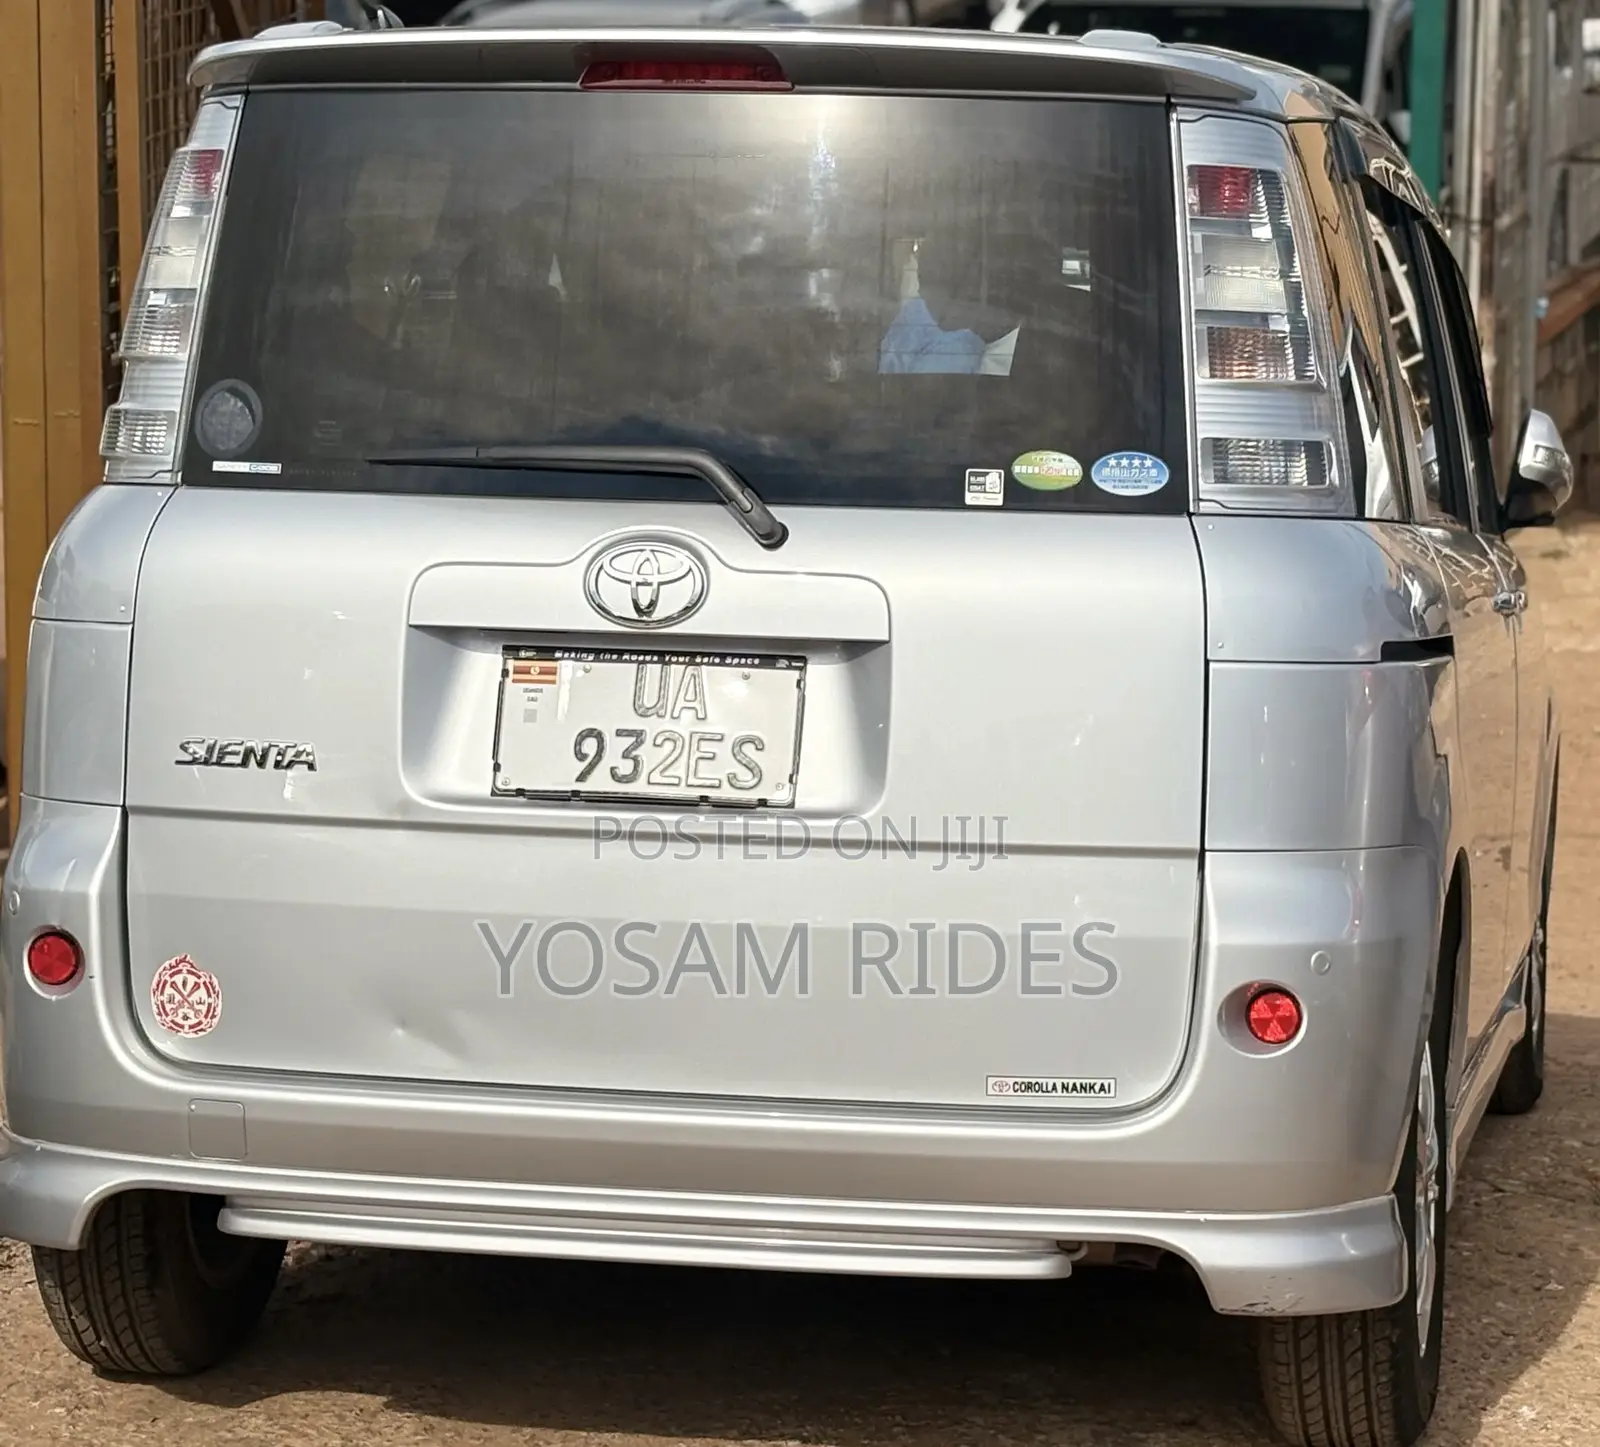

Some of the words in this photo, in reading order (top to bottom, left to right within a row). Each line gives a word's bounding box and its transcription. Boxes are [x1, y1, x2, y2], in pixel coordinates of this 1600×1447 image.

[664, 654, 692, 662] Your
[724, 656, 760, 665] Space
[633, 664, 707, 720] UA
[175, 737, 317, 771] SIENTA
[574, 727, 765, 790] 932ES
[1012, 1081, 1058, 1093] COROLLA
[1061, 1082, 1111, 1094] NANKAI
